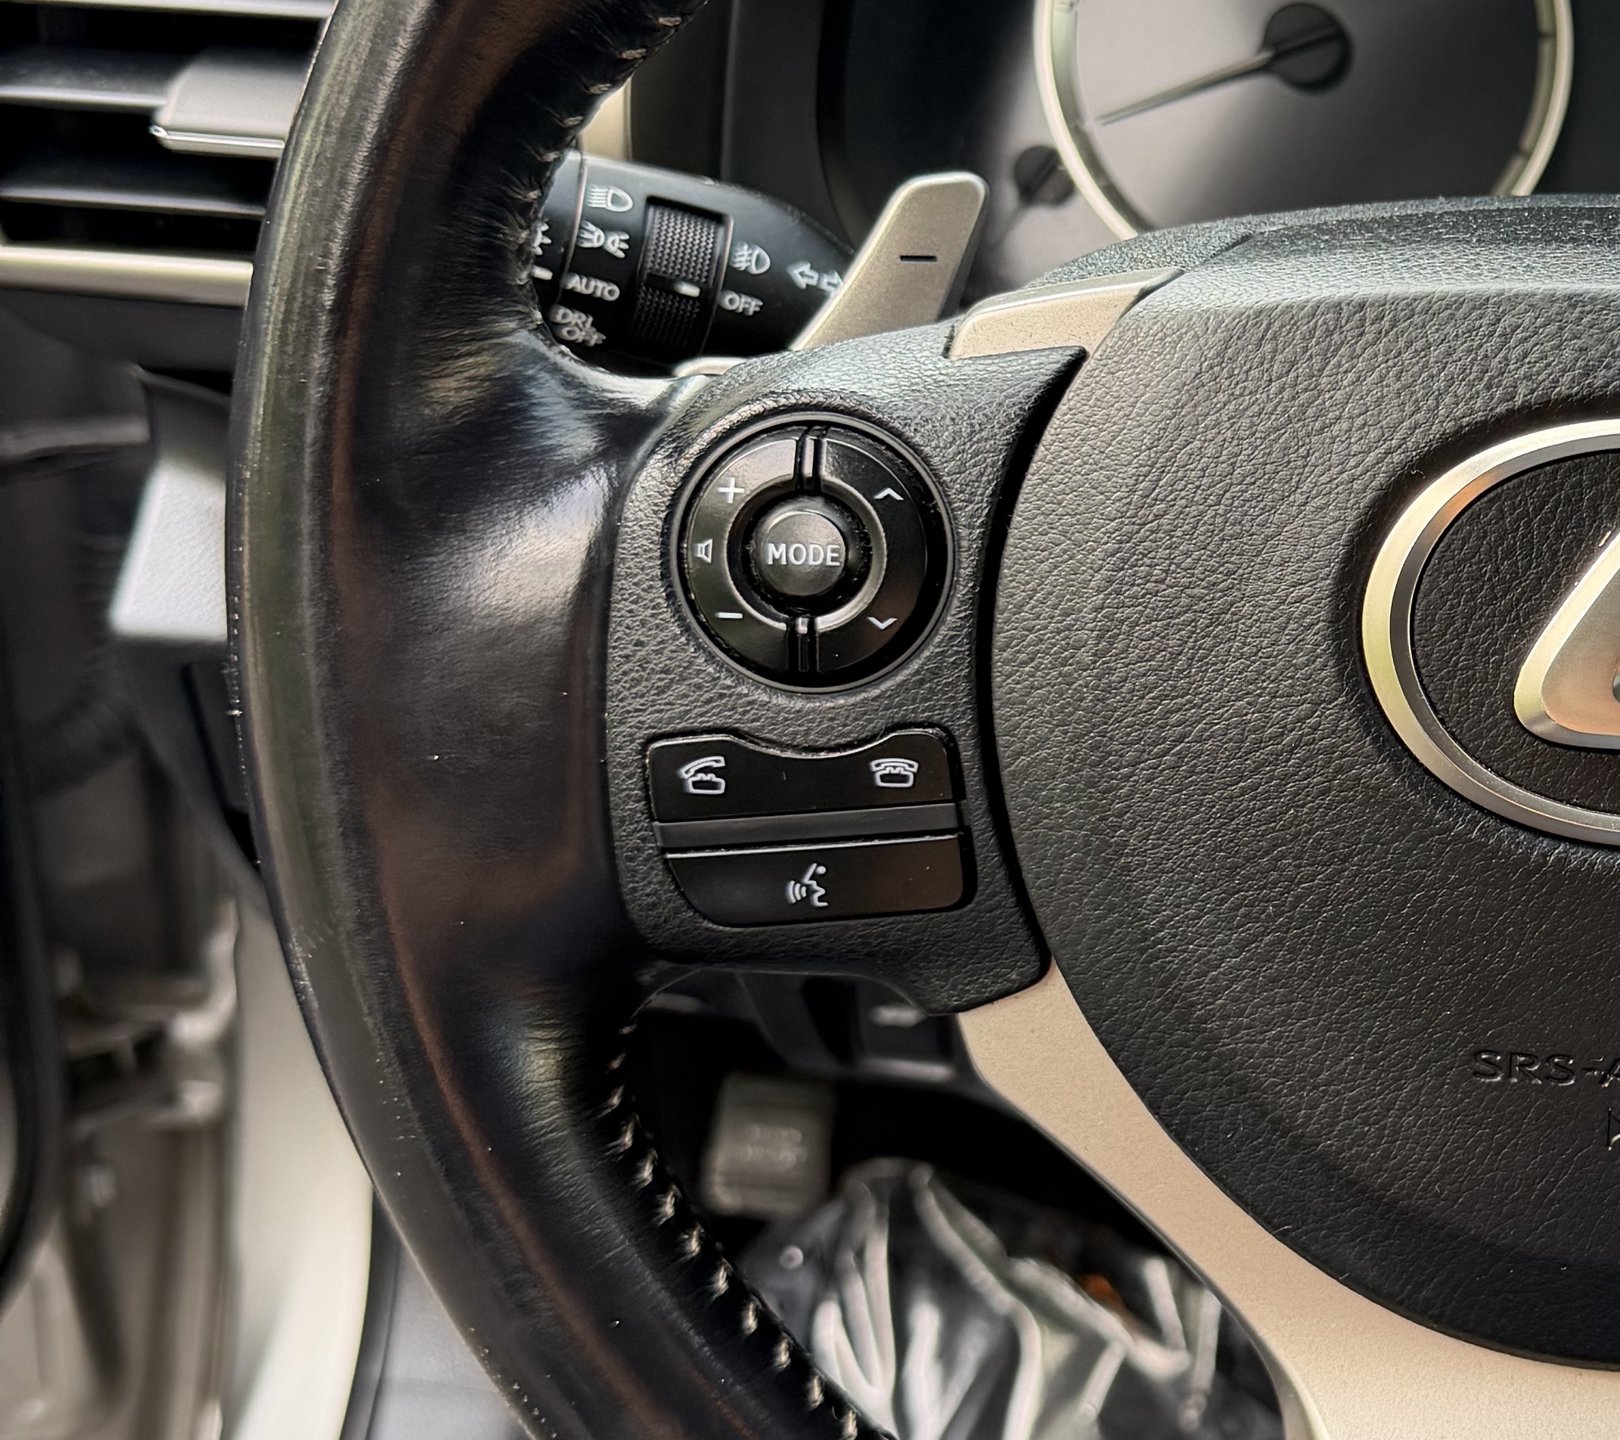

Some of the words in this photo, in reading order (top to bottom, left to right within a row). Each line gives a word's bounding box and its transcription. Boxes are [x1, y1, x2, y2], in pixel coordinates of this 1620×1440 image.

[564, 273, 620, 302] AUTO
[719, 290, 764, 317] OFF
[767, 542, 842, 567] MODE
